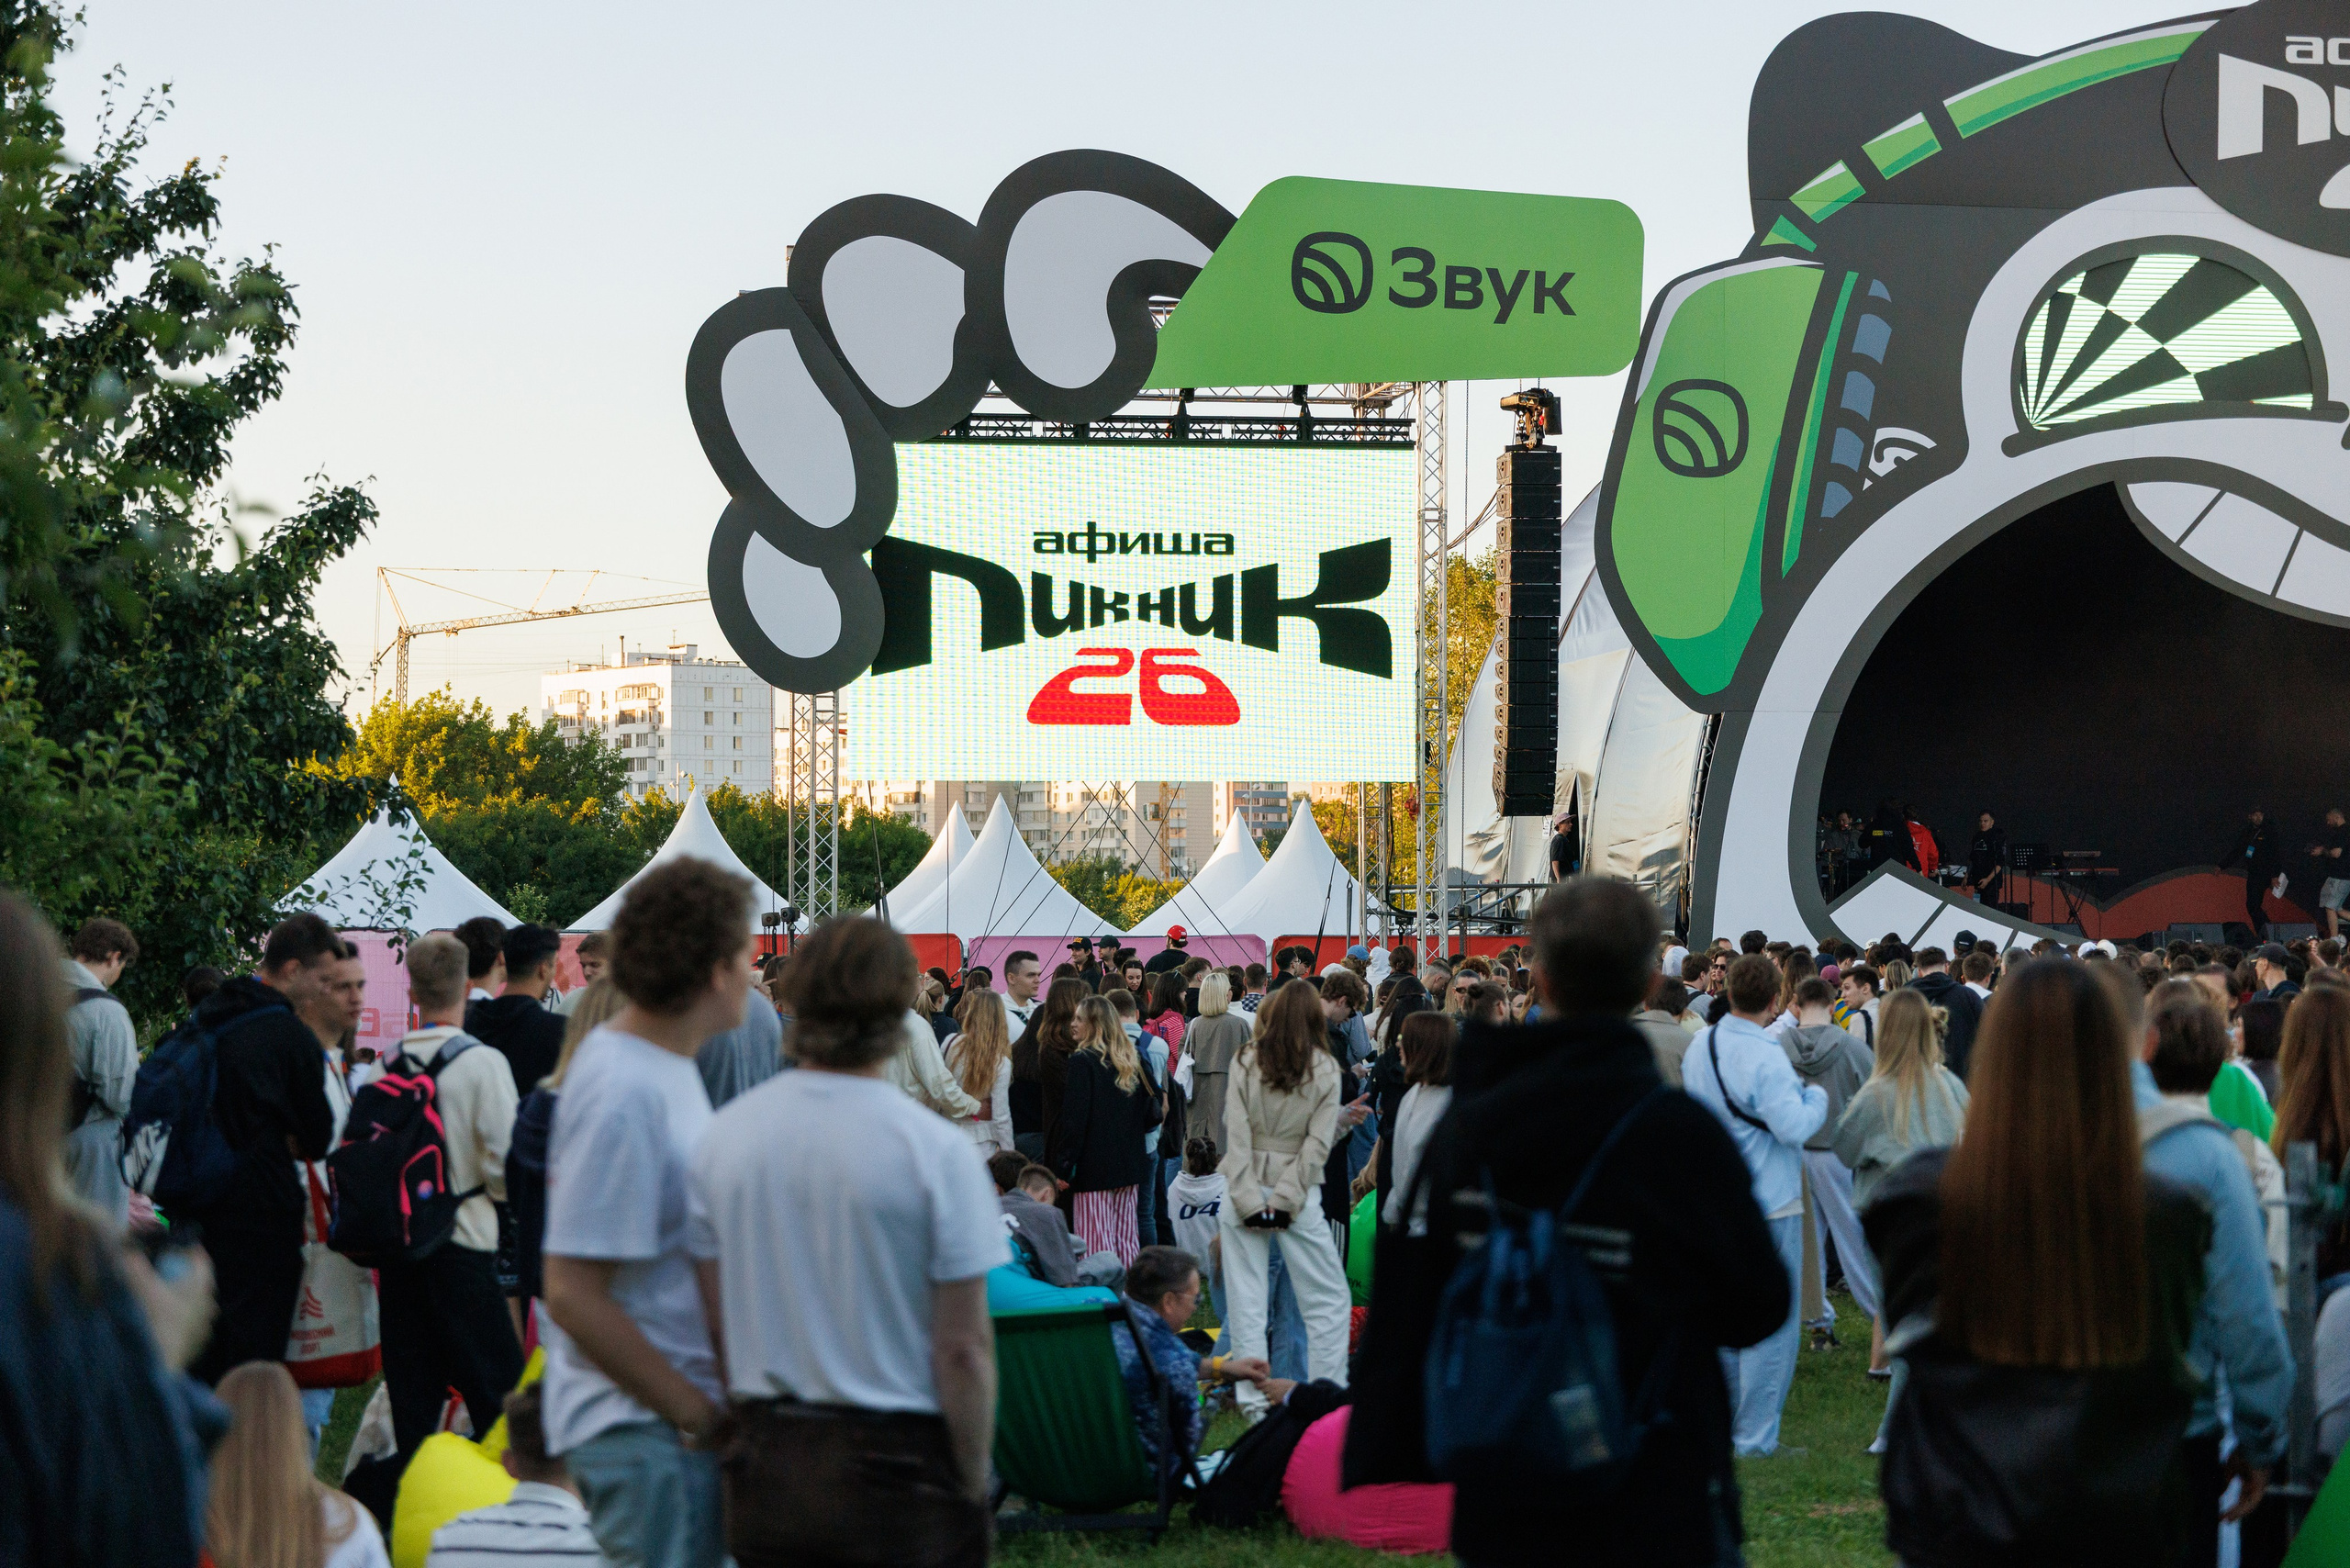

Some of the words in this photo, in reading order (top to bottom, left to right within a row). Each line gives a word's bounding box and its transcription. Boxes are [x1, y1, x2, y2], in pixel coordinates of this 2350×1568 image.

[1388, 246, 1577, 324] Звук
[1033, 521, 1235, 564] афиша
[1026, 647, 1241, 726] 26
[1179, 1201, 1221, 1221] 04
